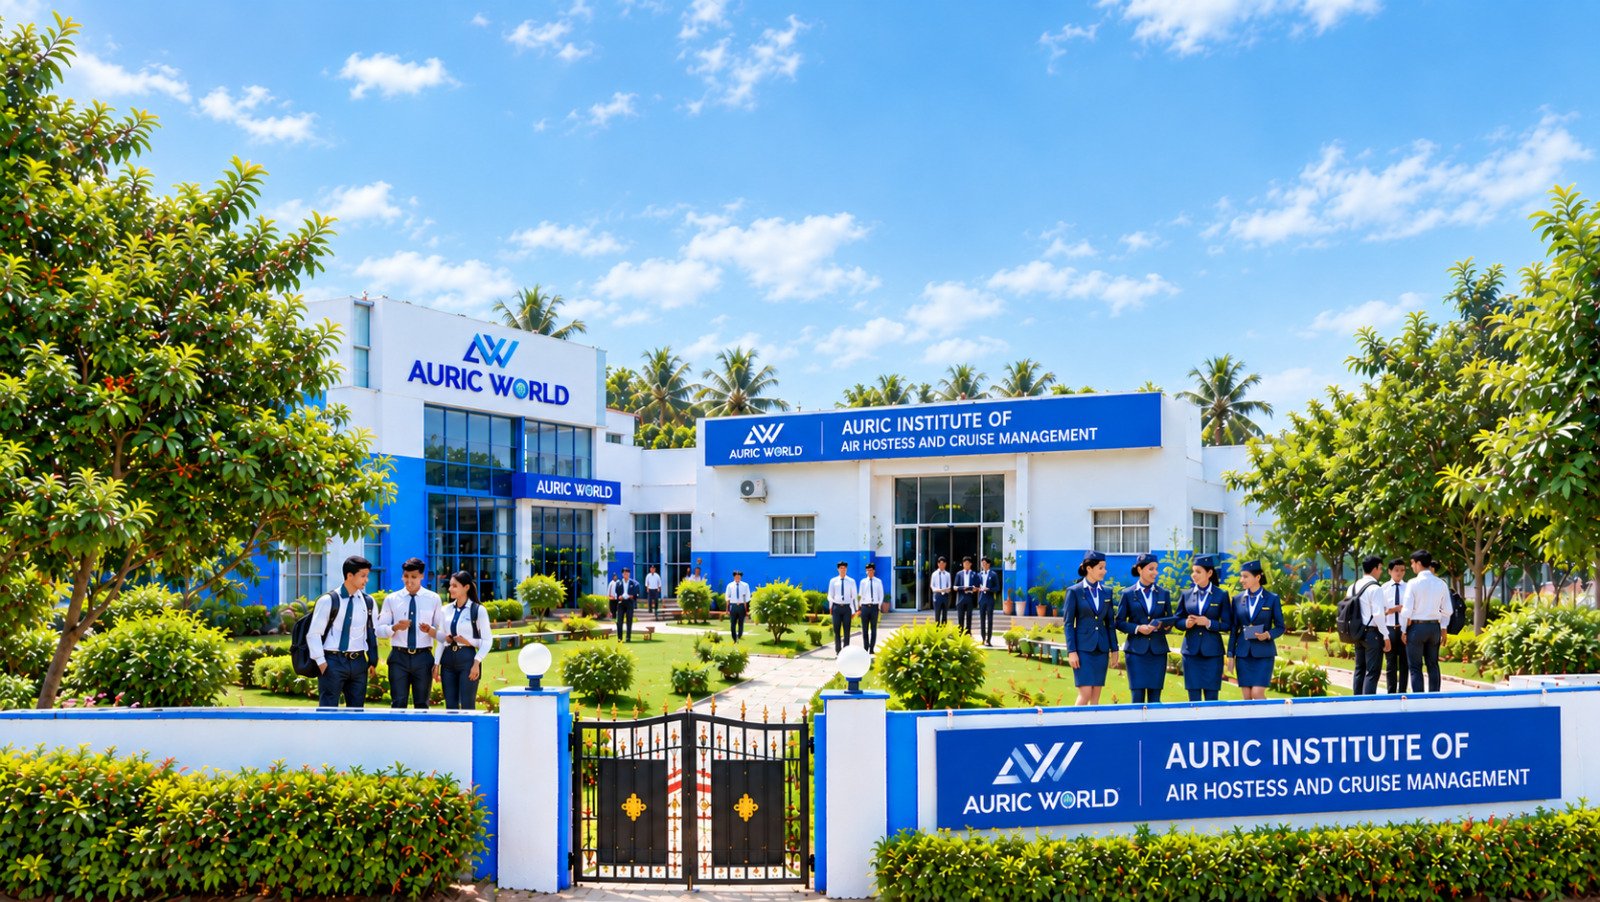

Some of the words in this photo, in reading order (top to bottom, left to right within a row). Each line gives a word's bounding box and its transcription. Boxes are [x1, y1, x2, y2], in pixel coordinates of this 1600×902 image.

[407, 359, 483, 393] AURIC
[488, 372, 569, 406] WORLD
[841, 417, 891, 435] AURIC
[897, 412, 982, 432] INSTITUTE
[988, 410, 1012, 427] OF
[729, 447, 761, 459] AURIC
[763, 445, 803, 457] WORLD
[840, 440, 860, 452] AIR
[863, 436, 916, 451] HOSTESS
[918, 435, 946, 449] AND
[949, 433, 995, 447] CRUISE
[999, 427, 1098, 445] MANAGEMENT
[536, 479, 572, 496] AURIC
[574, 483, 613, 499] WORLD
[1165, 739, 1262, 770] AURIC
[1272, 733, 1422, 766] INSTITUTE
[1431, 732, 1470, 760] OF
[1165, 783, 1198, 802] AIR
[1204, 778, 1288, 800] HOSTESS
[1293, 777, 1333, 796] AND
[1338, 774, 1402, 794] CRUISE
[1407, 768, 1530, 791] MANAGEMENT
[962, 792, 1032, 815] AURIC
[1037, 788, 1119, 810] WORLD
